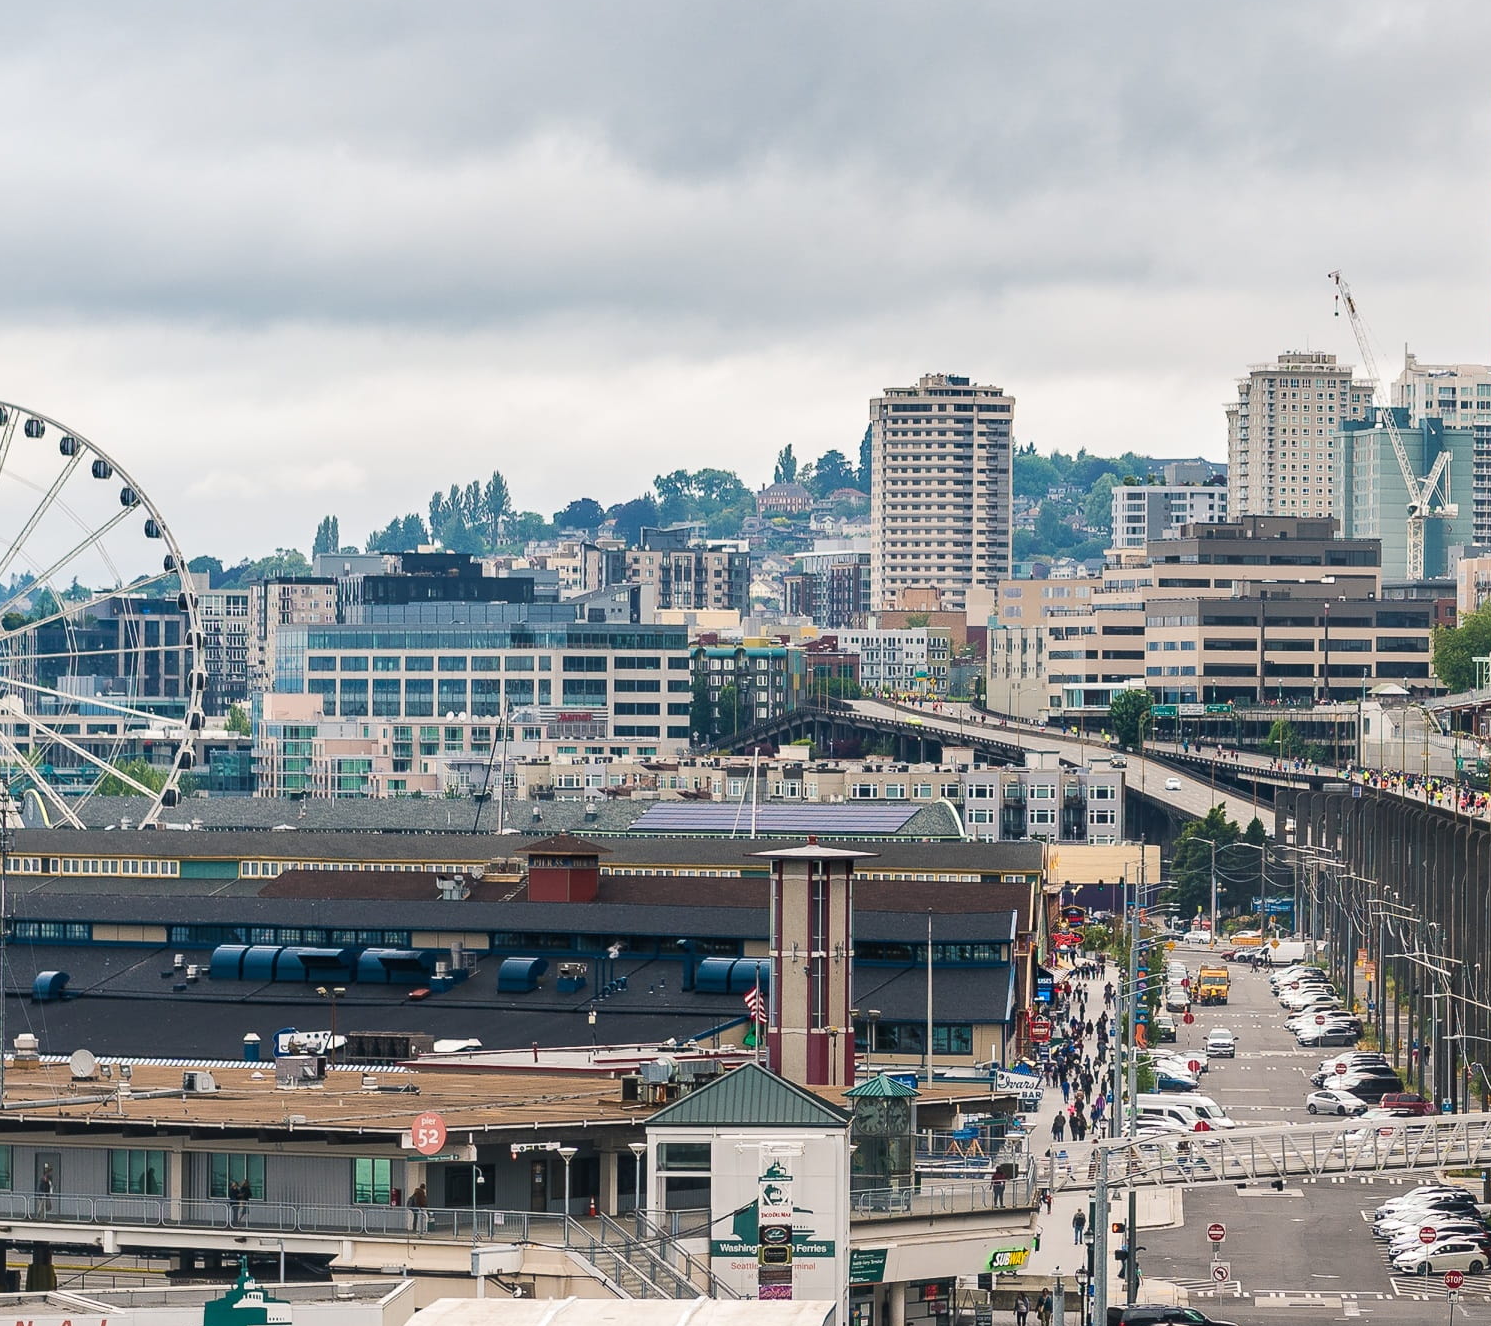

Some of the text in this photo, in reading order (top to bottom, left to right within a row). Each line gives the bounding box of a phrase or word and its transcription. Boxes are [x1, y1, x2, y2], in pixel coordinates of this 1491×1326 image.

[1021, 1091, 1042, 1099] BAR
[421, 1116, 437, 1126] pier
[417, 1129, 439, 1147] 52
[796, 1243, 827, 1253] Ferries
[993, 1250, 1030, 1267] SUBWAY
[1445, 1275, 1463, 1284] STOP
